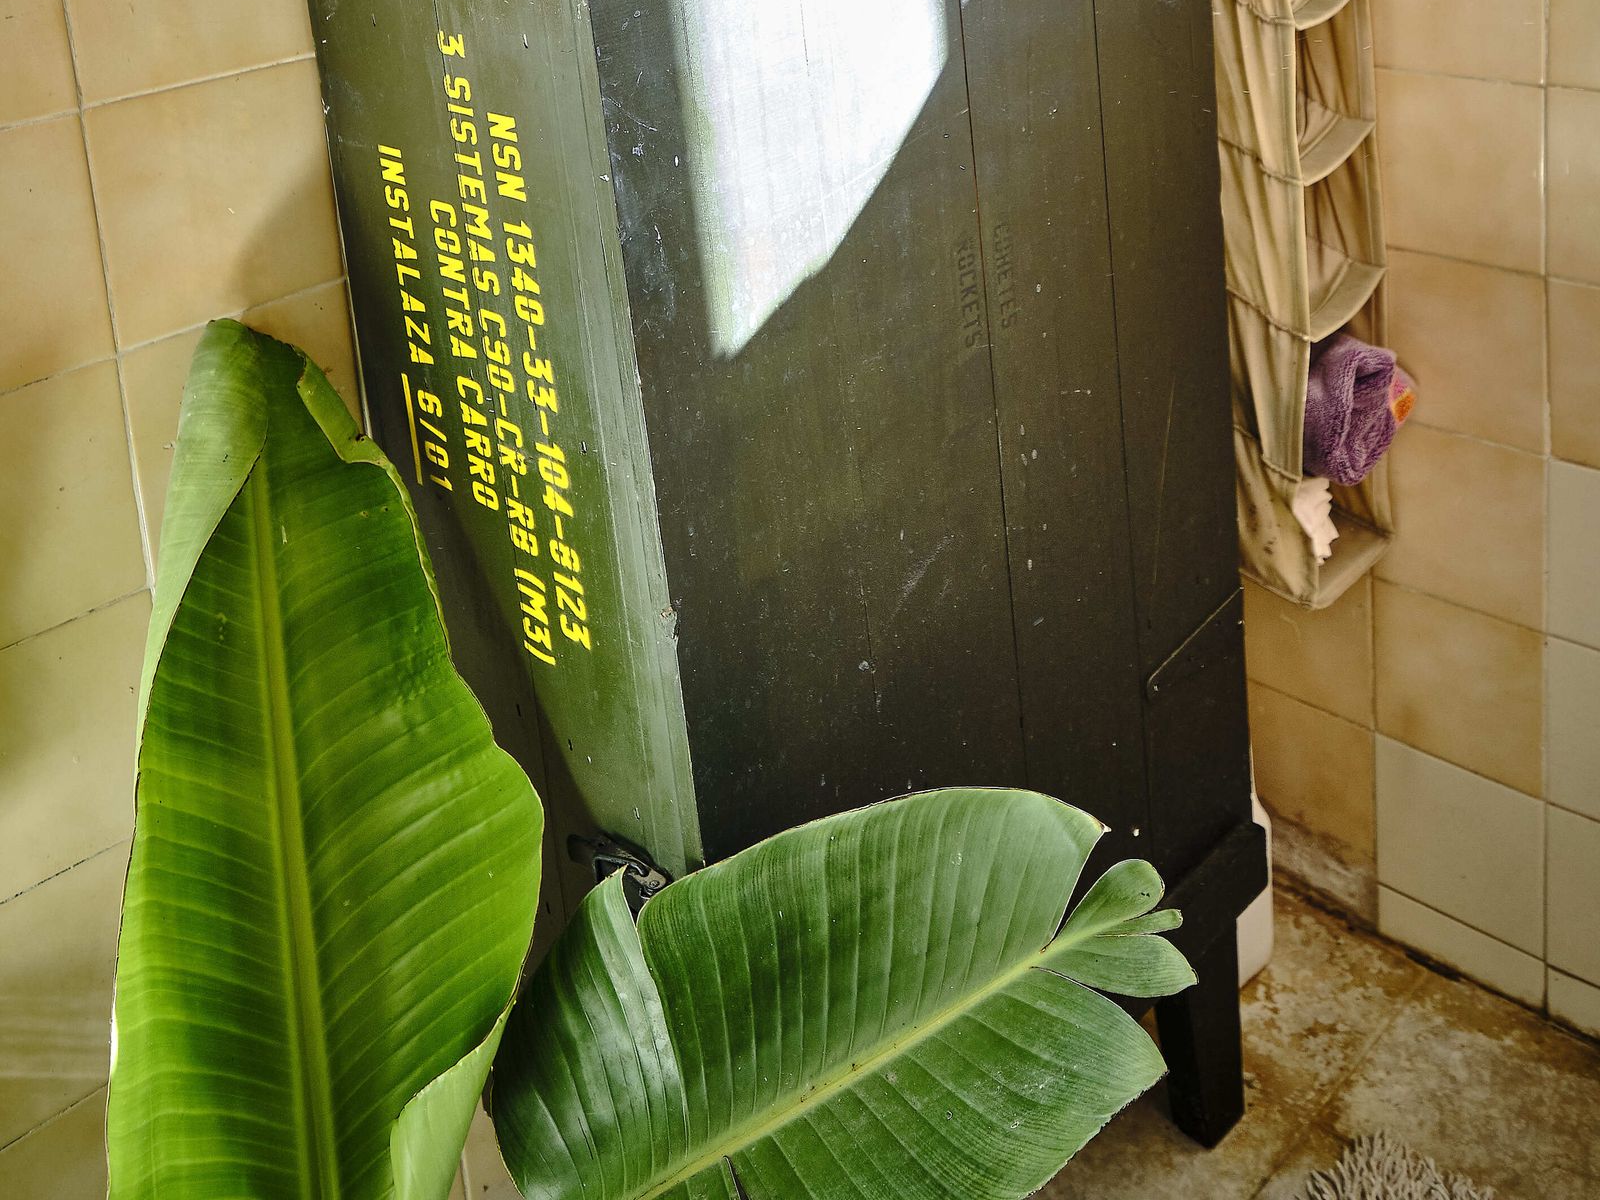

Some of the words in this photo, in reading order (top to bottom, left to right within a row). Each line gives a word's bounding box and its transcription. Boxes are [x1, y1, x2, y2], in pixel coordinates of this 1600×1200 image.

[437, 30, 466, 58] 3
[486, 111, 527, 203] NSN
[443, 73, 501, 296] SISTEMAS
[377, 143, 434, 366] INSTALAZA
[416, 388, 453, 492] 6/01
[429, 199, 477, 359] CONTRA
[456, 374, 500, 511] CARRO
[478, 308, 540, 557] C90-CR-RB
[503, 219, 591, 651] 1340-33-104-8123
[513, 567, 556, 666] (M3)
